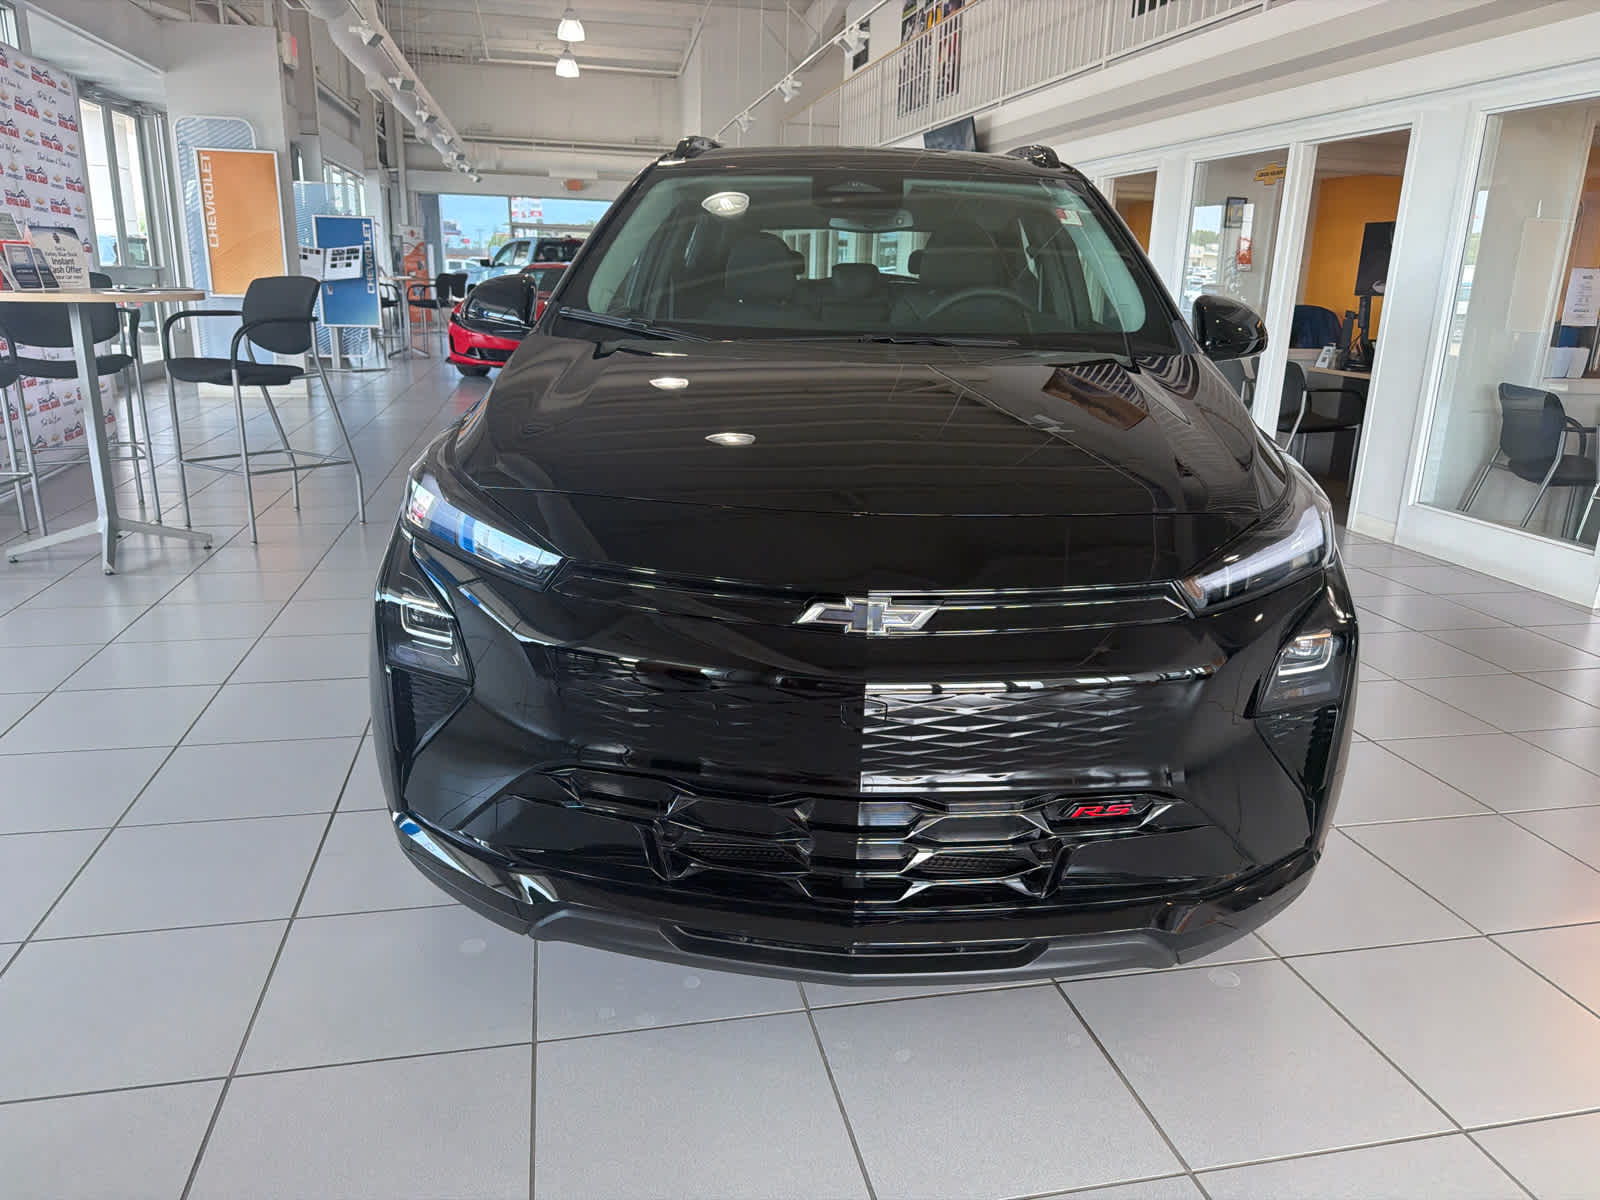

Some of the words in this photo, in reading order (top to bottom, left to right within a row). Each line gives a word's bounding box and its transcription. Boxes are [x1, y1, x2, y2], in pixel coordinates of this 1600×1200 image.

[200, 154, 219, 248] CHEVROLET
[65, 265, 82, 274] Offer
[362, 223, 376, 294] CHEVROLET
[1071, 803, 1134, 818] RS
